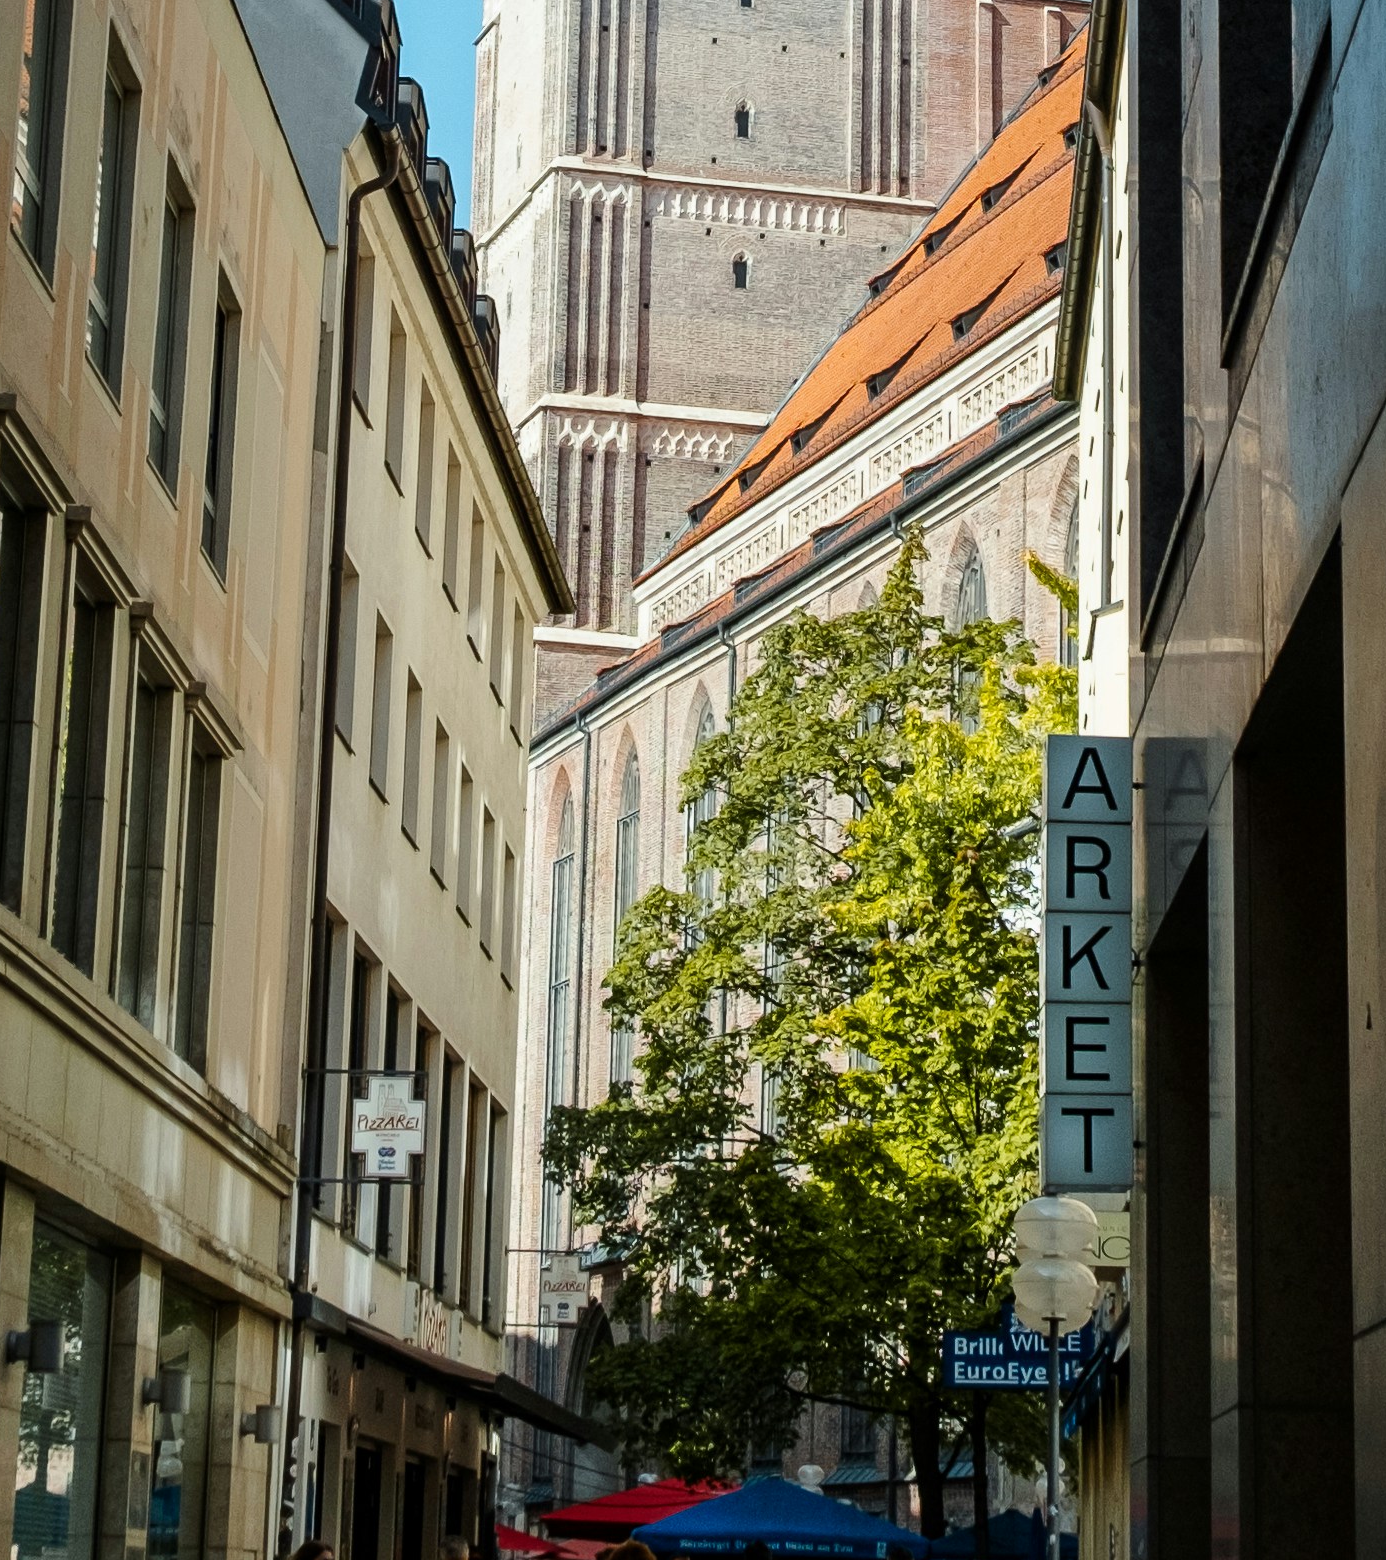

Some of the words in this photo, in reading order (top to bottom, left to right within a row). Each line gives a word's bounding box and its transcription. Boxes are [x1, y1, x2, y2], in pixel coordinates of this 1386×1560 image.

[1061, 746, 1119, 1174] ARKET
[357, 1114, 420, 1130] PIZZAREI
[954, 1361, 1060, 1385] EuroEye
